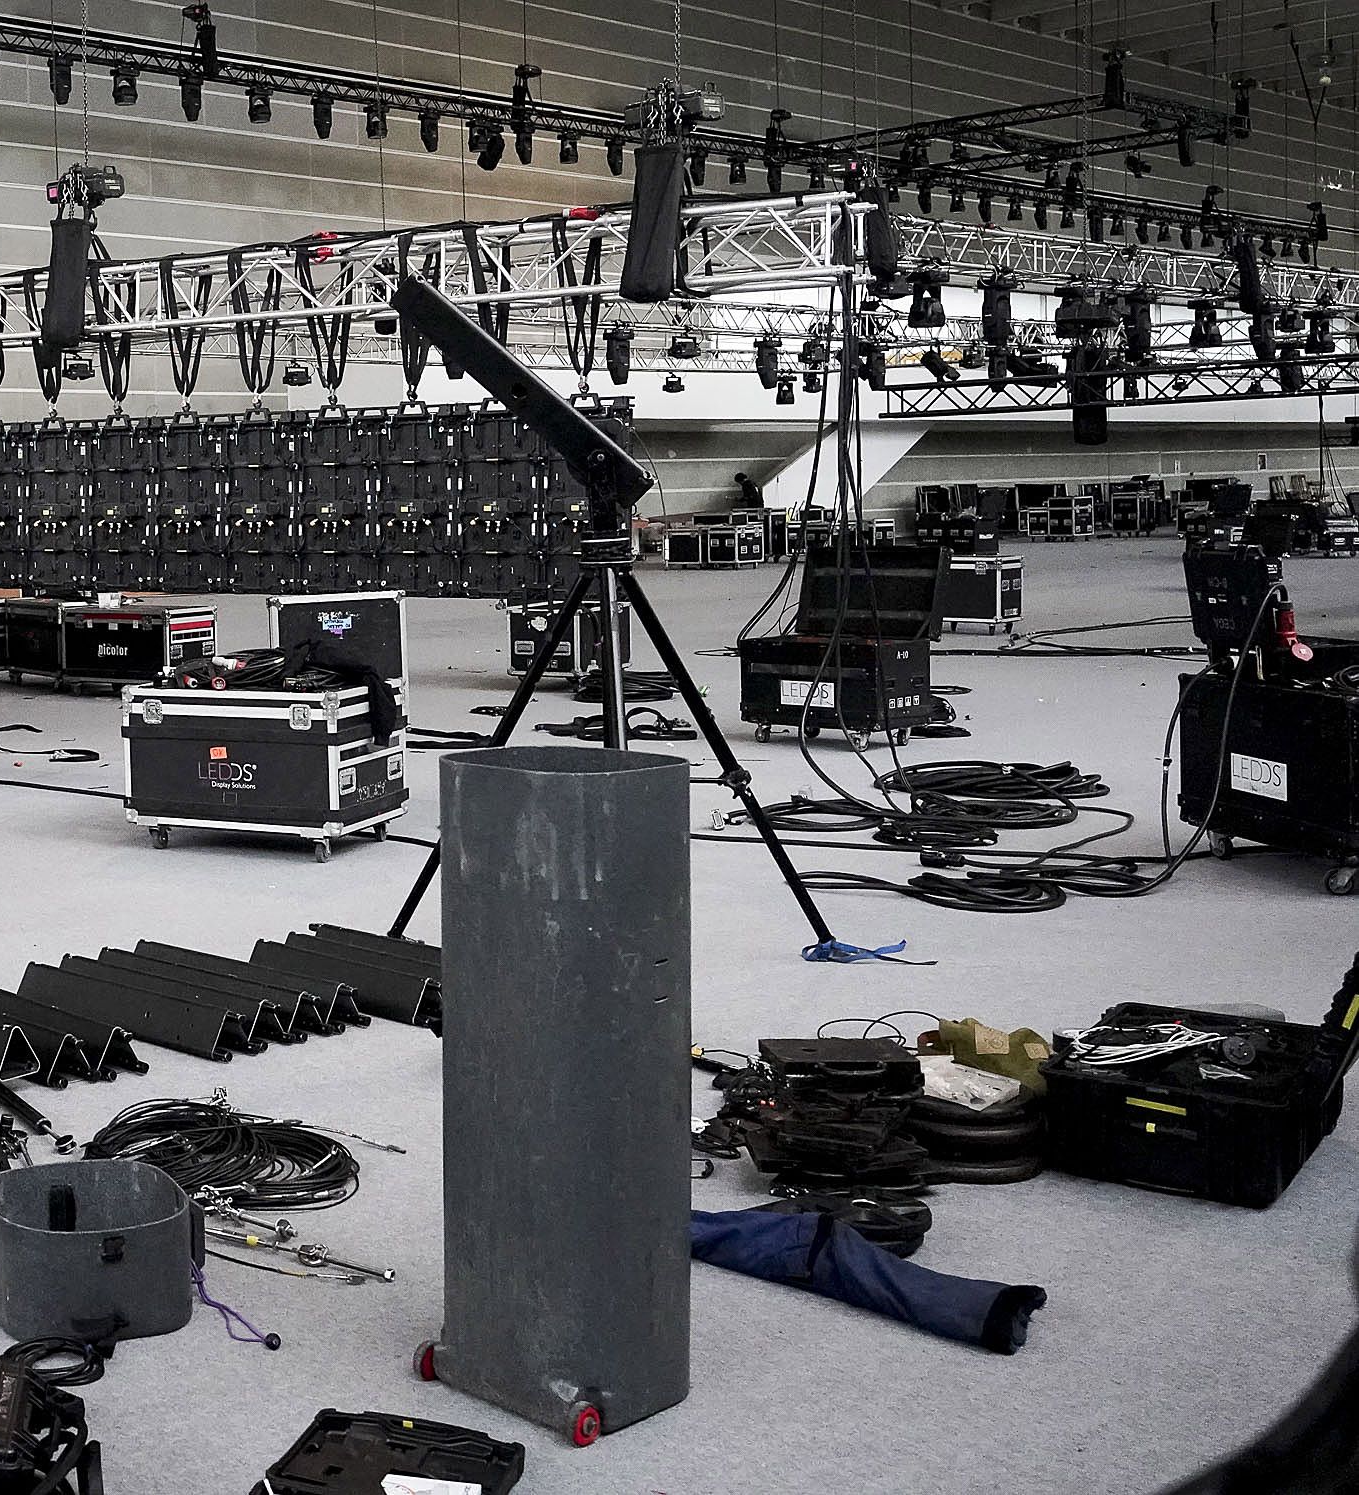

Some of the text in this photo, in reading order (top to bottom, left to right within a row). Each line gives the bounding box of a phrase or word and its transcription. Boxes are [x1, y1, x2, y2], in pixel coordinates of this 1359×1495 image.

[98, 643, 129, 658] Dicolor
[198, 761, 253, 782] LEDDS
[1232, 754, 1282, 787] LEDDS
[211, 780, 257, 790] Display Solutions
